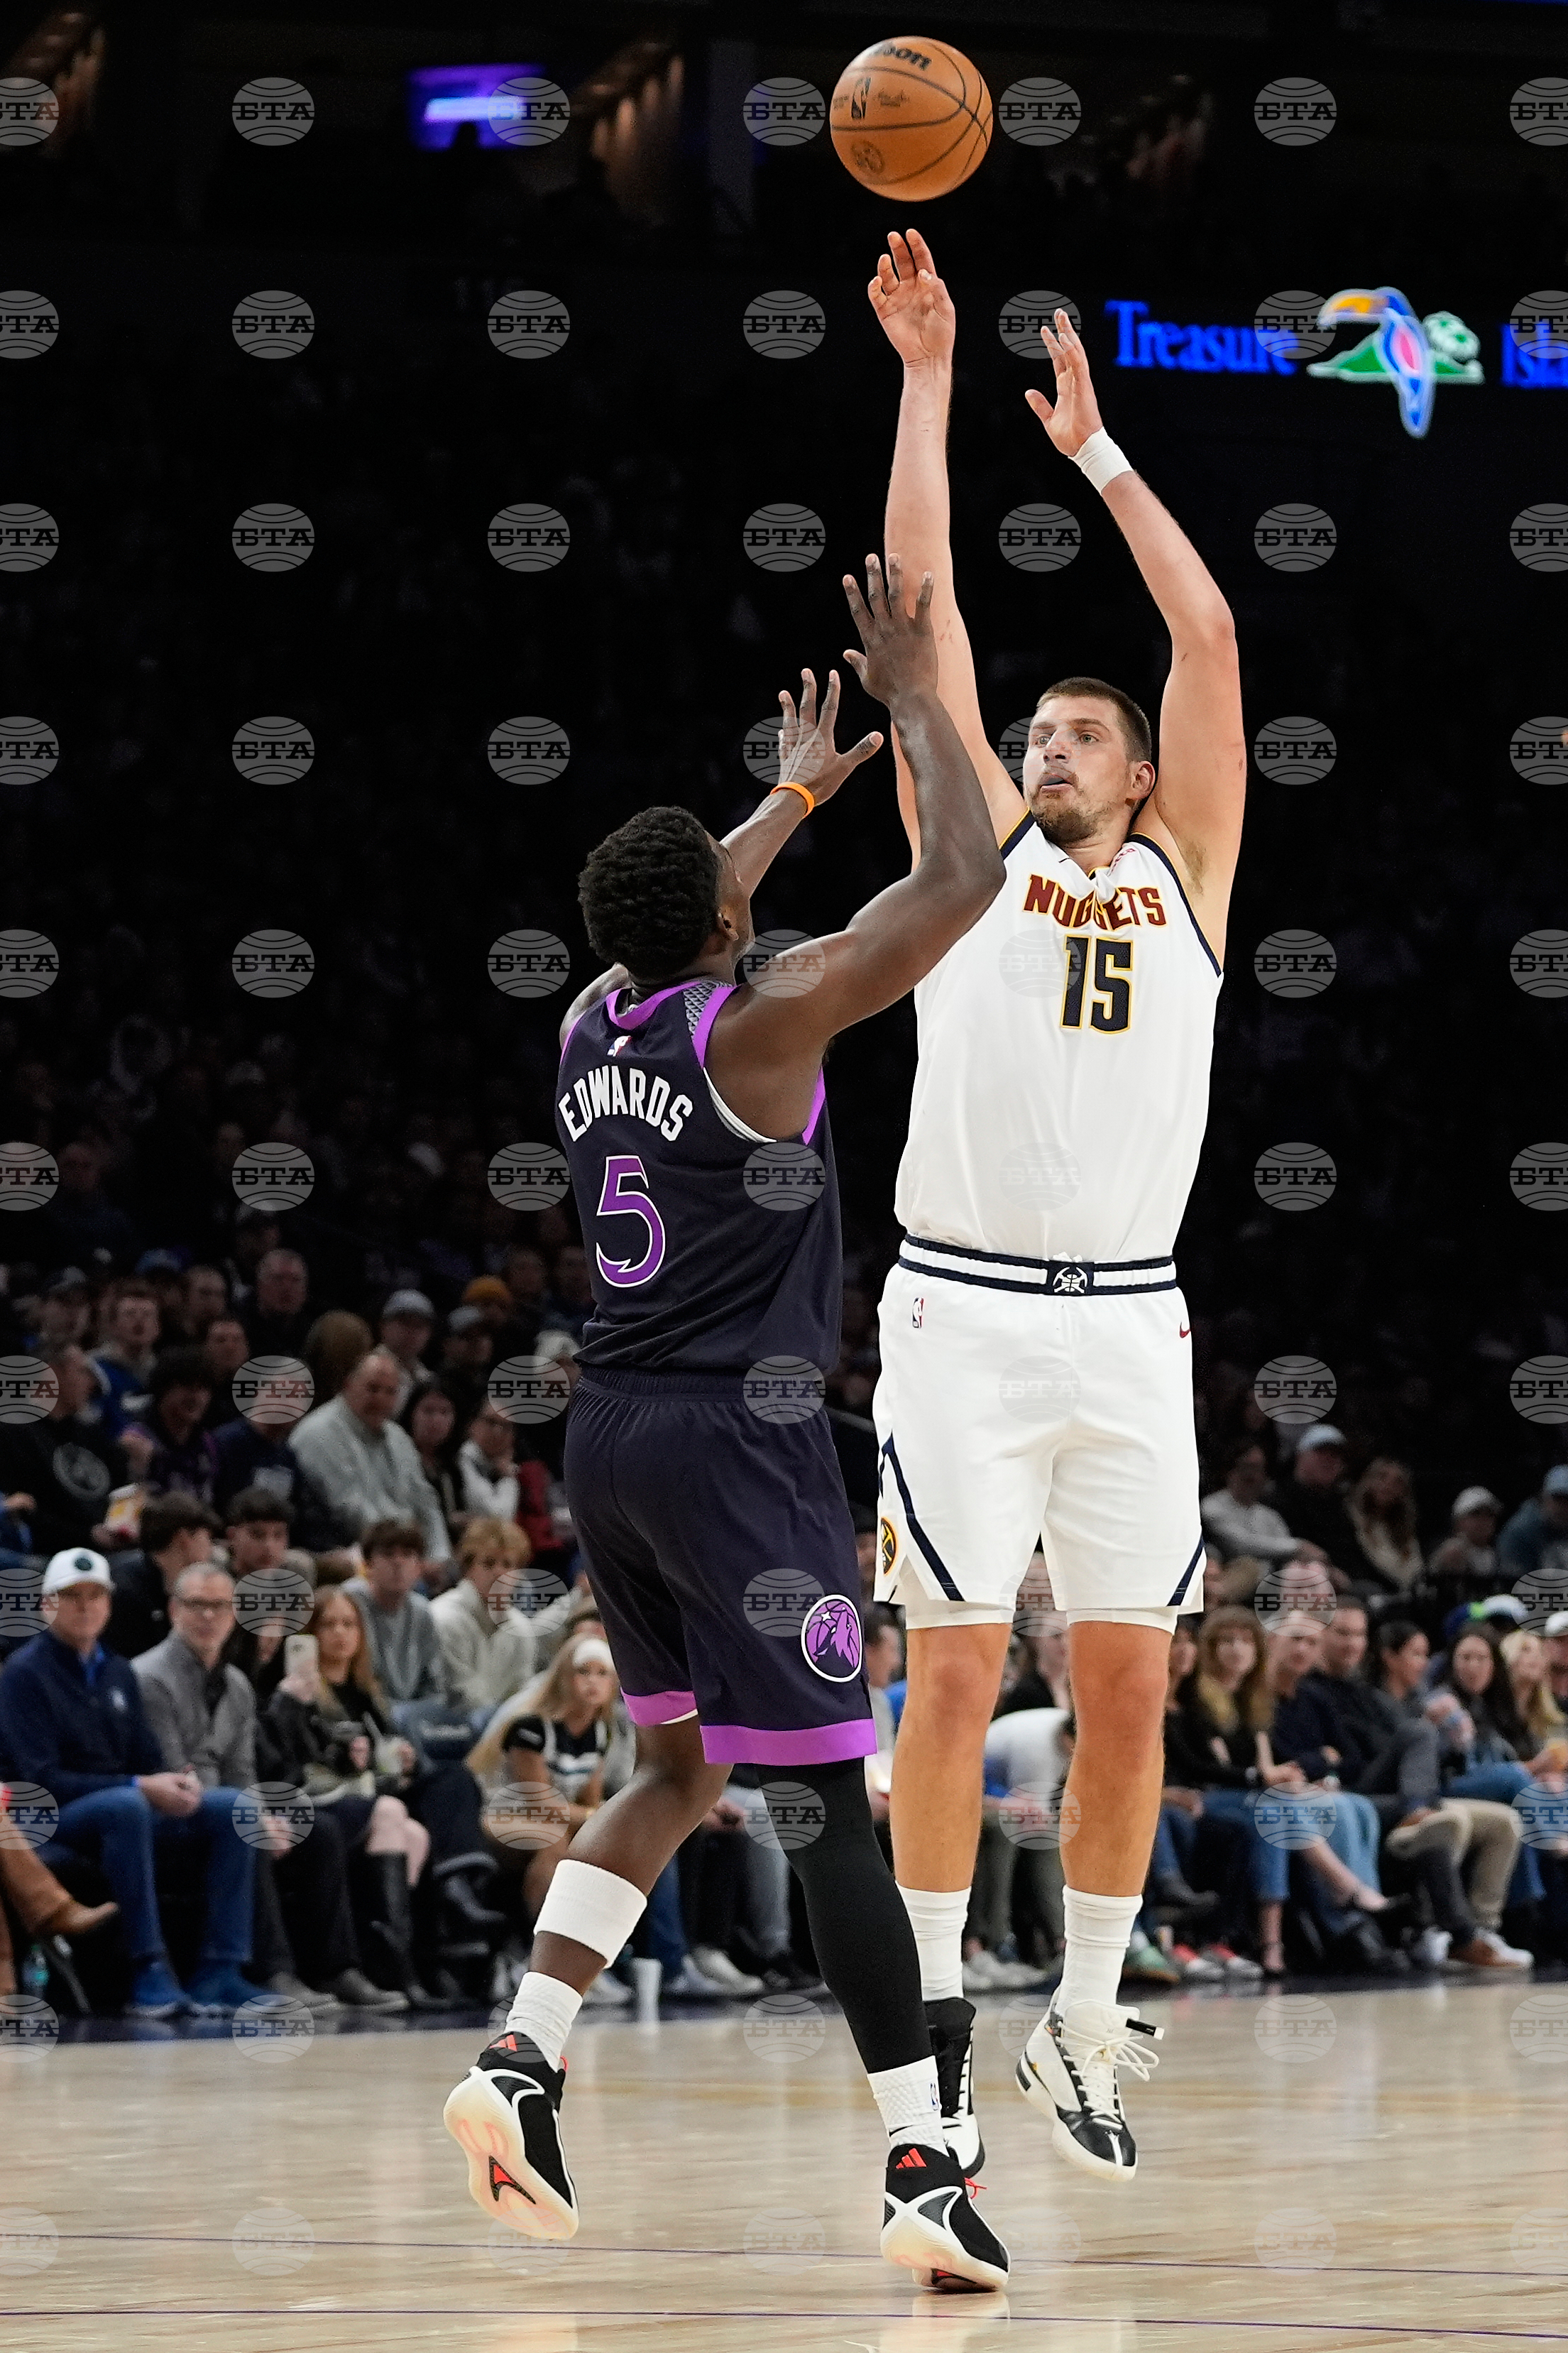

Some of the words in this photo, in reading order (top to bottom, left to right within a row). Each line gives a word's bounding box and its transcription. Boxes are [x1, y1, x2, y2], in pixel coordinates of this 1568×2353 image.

[1104, 298, 1297, 376] Treasure
[1060, 934, 1134, 1035] 15
[558, 1064, 693, 1142] EDWARDS
[596, 1154, 666, 1289] 5
